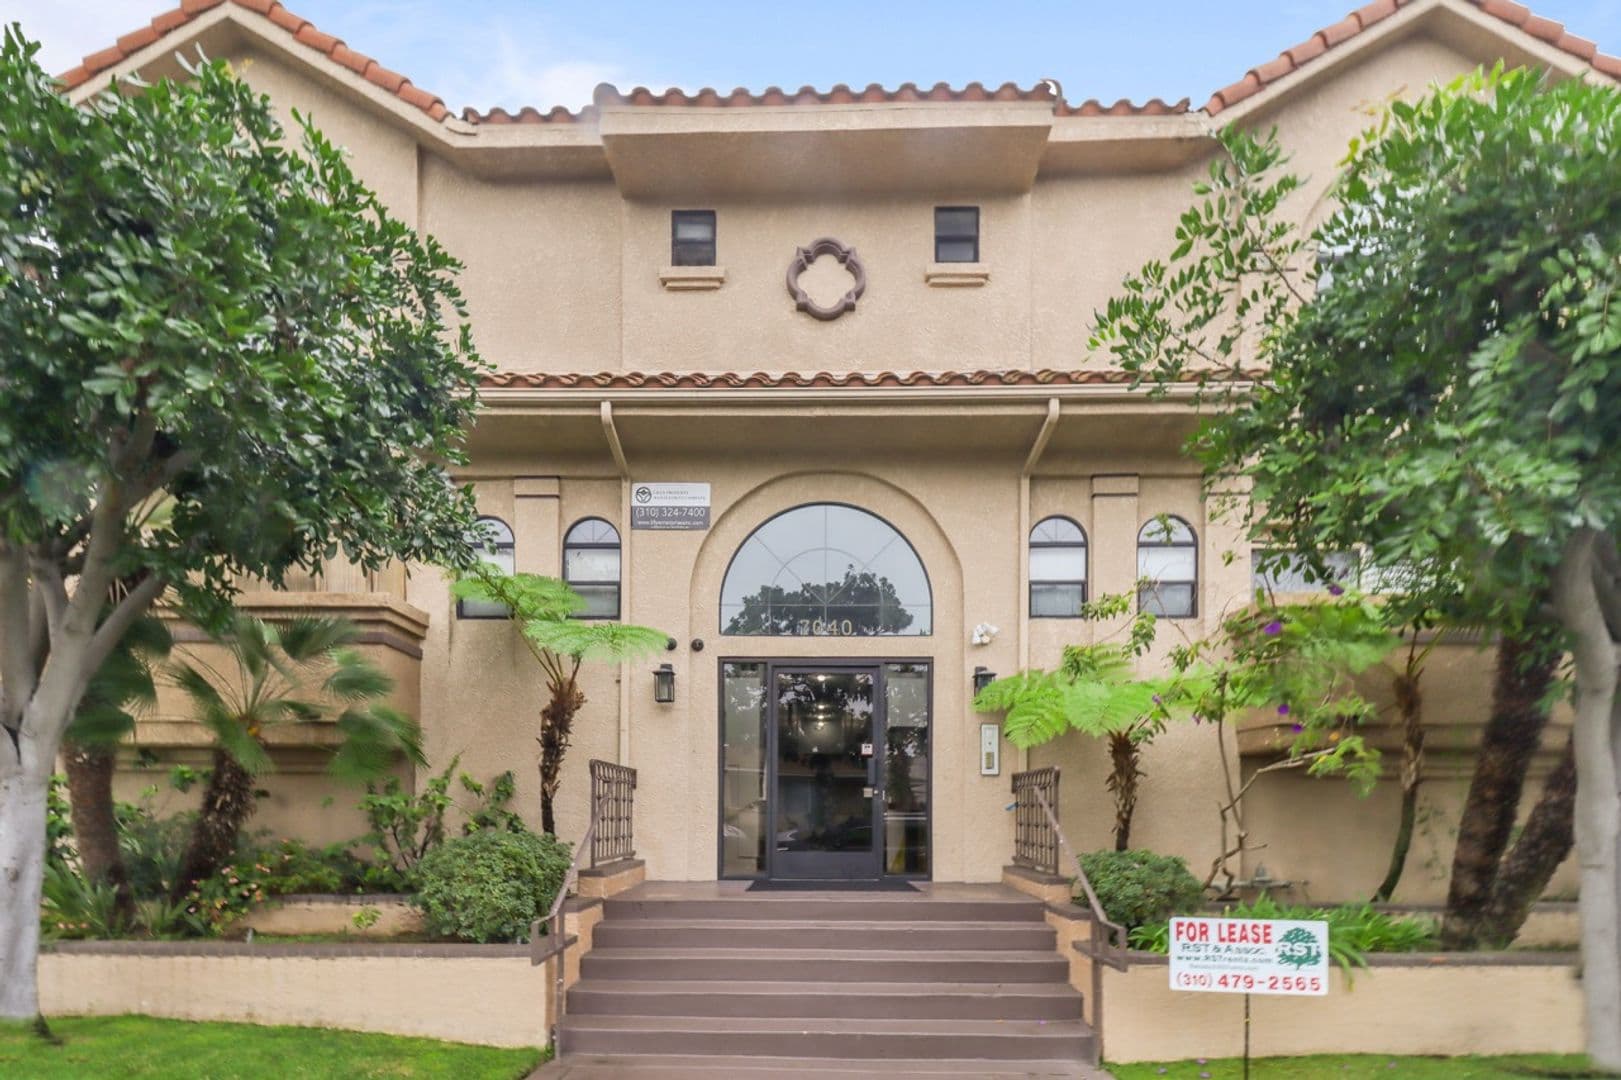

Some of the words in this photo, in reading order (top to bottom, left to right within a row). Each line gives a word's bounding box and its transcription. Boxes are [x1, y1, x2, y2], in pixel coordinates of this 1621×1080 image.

[635, 507, 659, 518] (310)
[662, 507, 705, 517] 324-7400
[800, 619, 852, 636] 7040
[1175, 921, 1209, 942] FOR
[1218, 922, 1272, 944] LEASE
[1182, 943, 1210, 952] RST
[1277, 942, 1321, 957] RST
[1176, 972, 1213, 987] (310)
[1218, 974, 1321, 991] 479-2565
